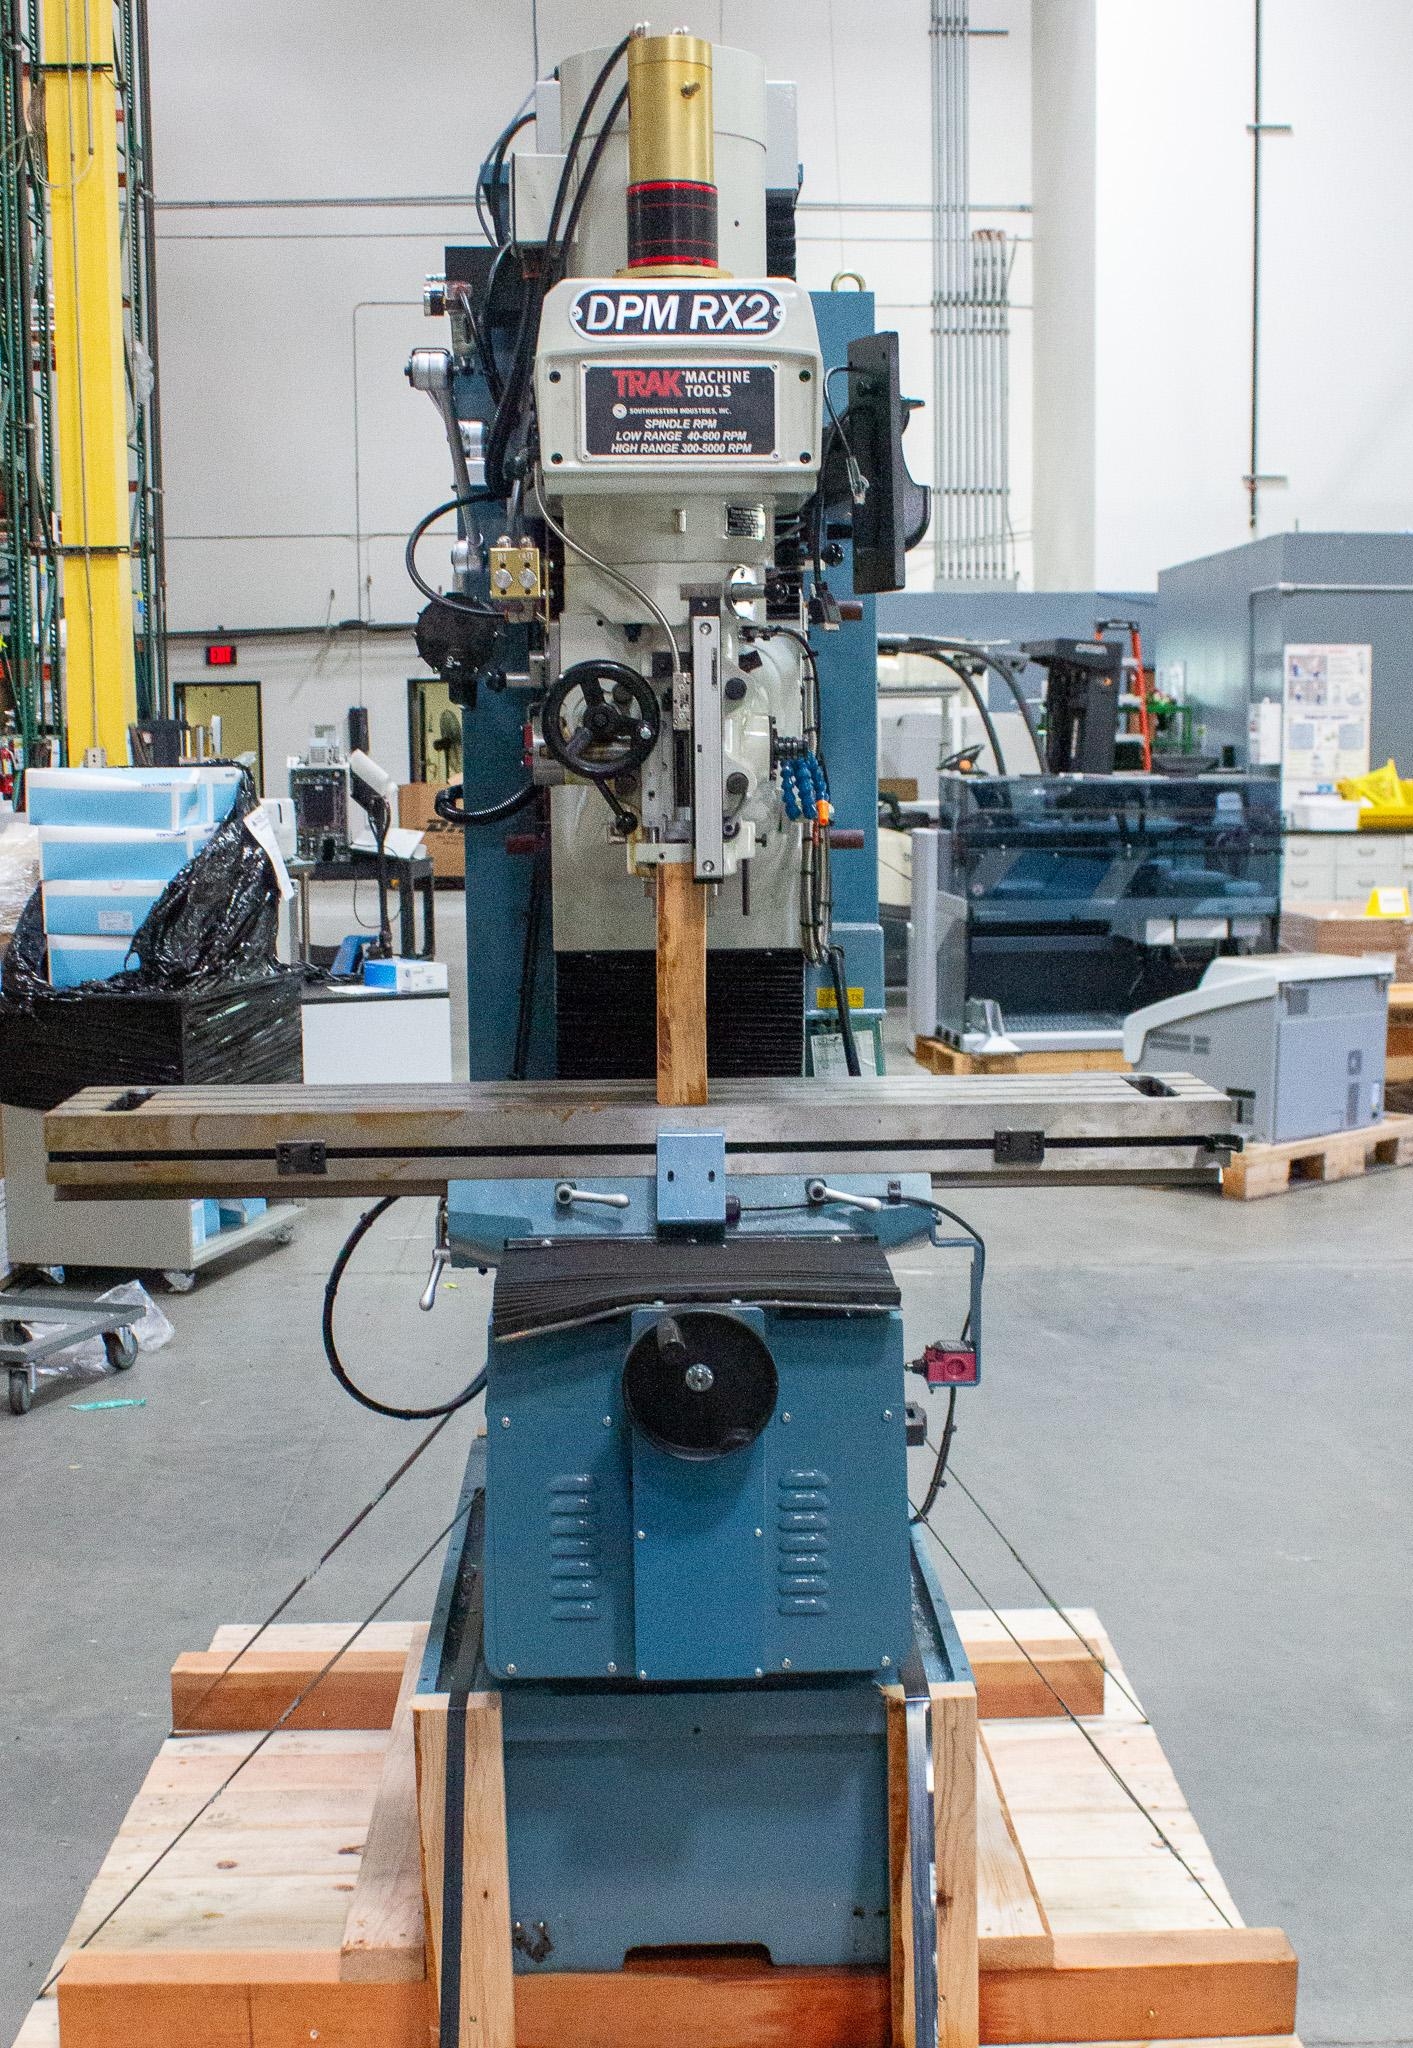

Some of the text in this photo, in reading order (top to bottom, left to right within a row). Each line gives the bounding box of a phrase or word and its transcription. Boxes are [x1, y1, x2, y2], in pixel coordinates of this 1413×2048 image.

[586, 294, 770, 331] DPM RX2
[685, 370, 751, 383] MACHINE
[612, 370, 683, 397] TRAK
[685, 385, 732, 398] TOOLS
[629, 407, 678, 415] SOUTHWESTERN
[719, 407, 732, 415] INC.
[644, 419, 718, 429] SPINDLE RPM
[615, 431, 747, 441] LOW RANGE 40-600 RPM
[610, 443, 752, 453] HIGH RANGE 300-5000 RPM
